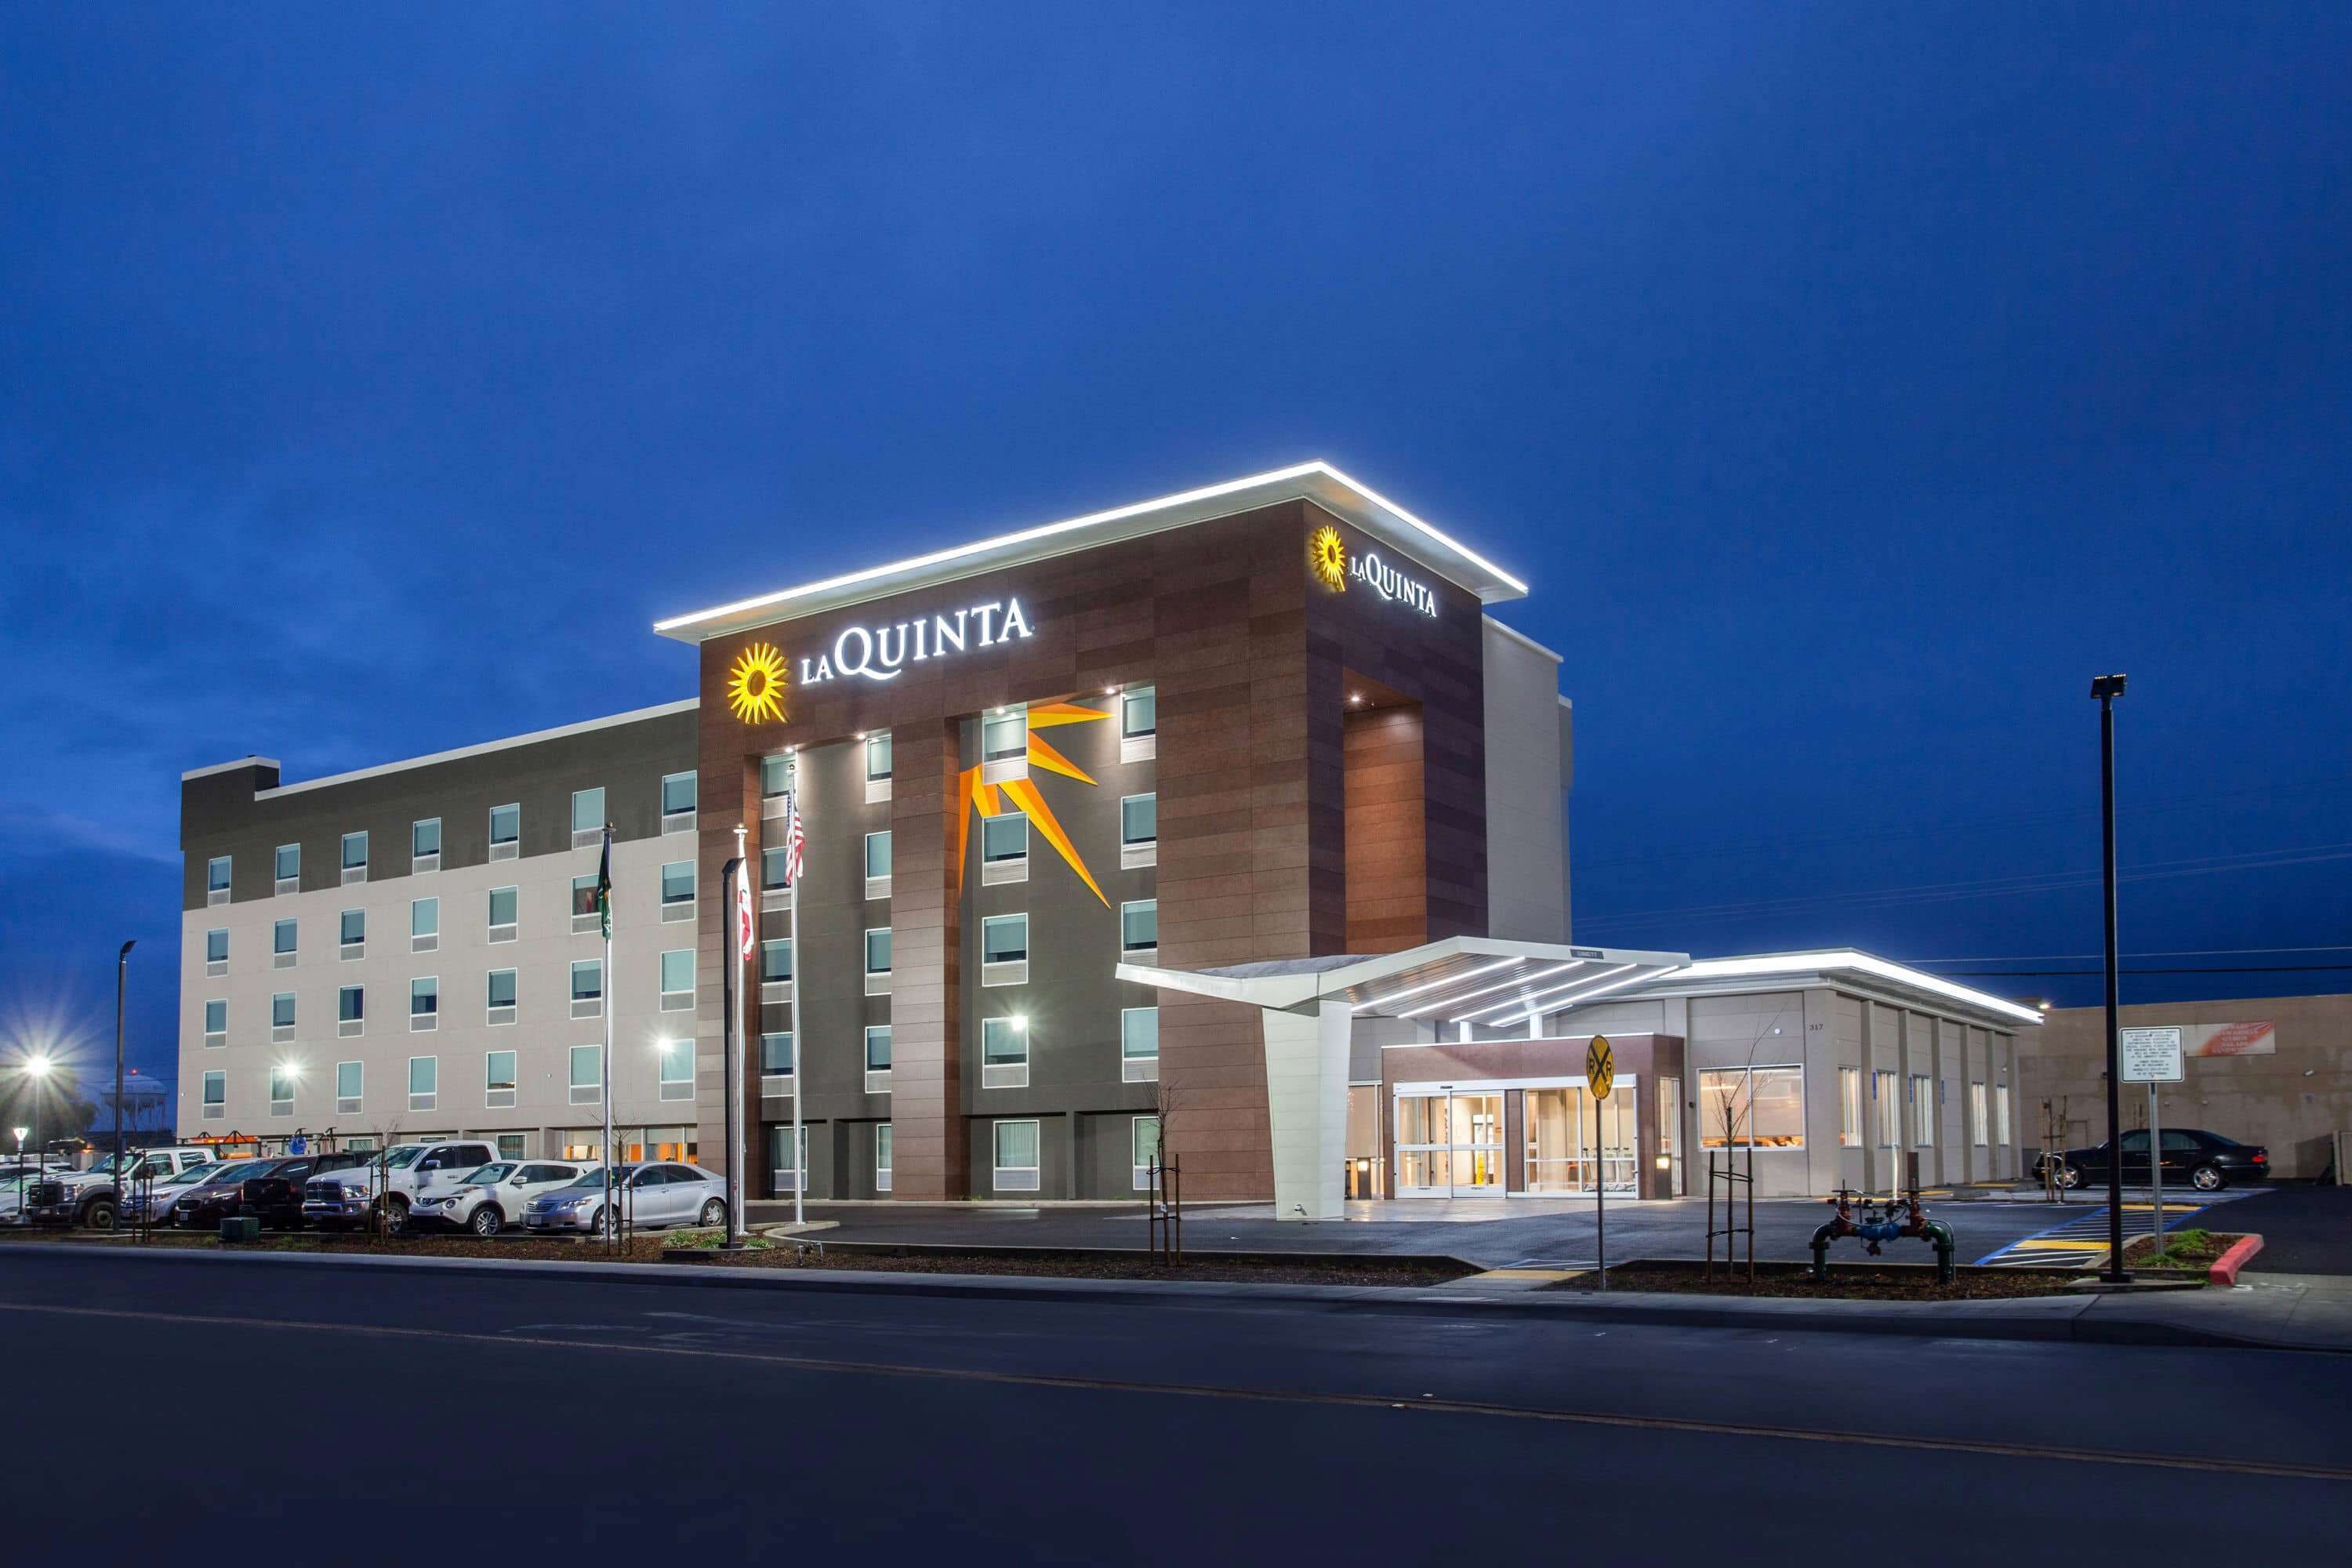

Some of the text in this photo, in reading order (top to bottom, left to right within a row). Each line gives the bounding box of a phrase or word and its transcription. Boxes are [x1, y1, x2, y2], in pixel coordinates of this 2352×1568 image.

[1350, 553, 1437, 618] LA QUINTA
[800, 597, 1033, 685] LA QUINTA
[1606, 1060, 1612, 1078] R
